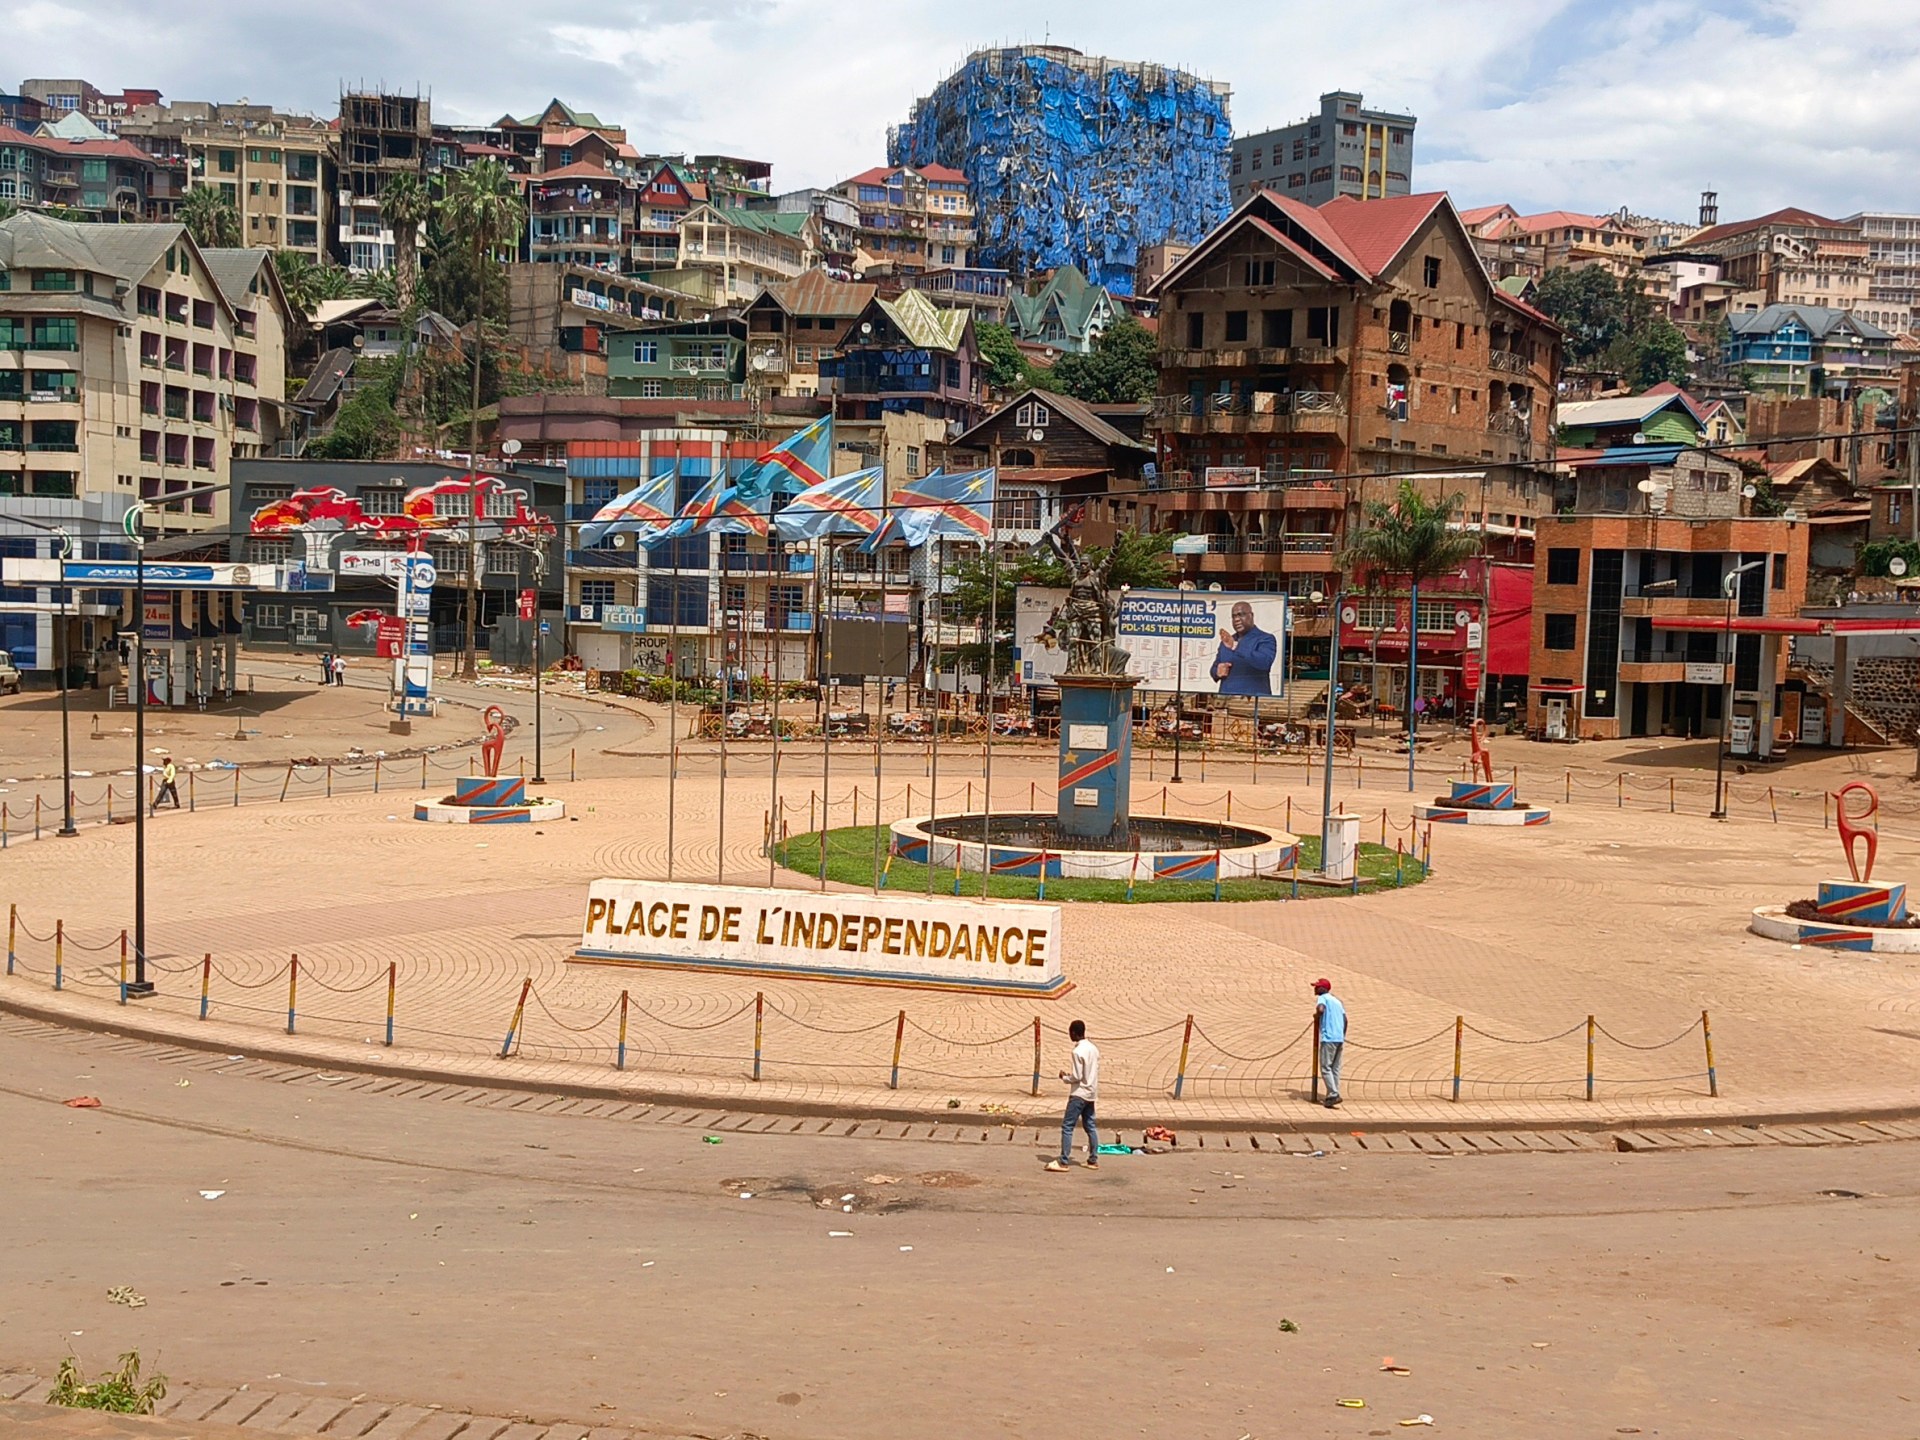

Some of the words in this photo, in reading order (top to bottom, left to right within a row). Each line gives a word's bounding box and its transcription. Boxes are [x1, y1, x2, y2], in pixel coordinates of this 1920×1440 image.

[362, 558, 380, 567] TMB
[145, 608, 158, 620] 24
[1121, 601, 1204, 615] PROGRAMME
[603, 612, 644, 625] TECNO
[1132, 615, 1191, 624] DEVELOPPEMENT
[145, 629, 169, 637] Diesel
[1121, 623, 1156, 632] PDL-145
[1157, 624, 1213, 635] TERRTOIRES
[634, 637, 667, 648] GROUP
[586, 898, 690, 938] PLACE
[700, 904, 742, 942] DE
[756, 906, 1047, 967] L'INDEPENDANCE
